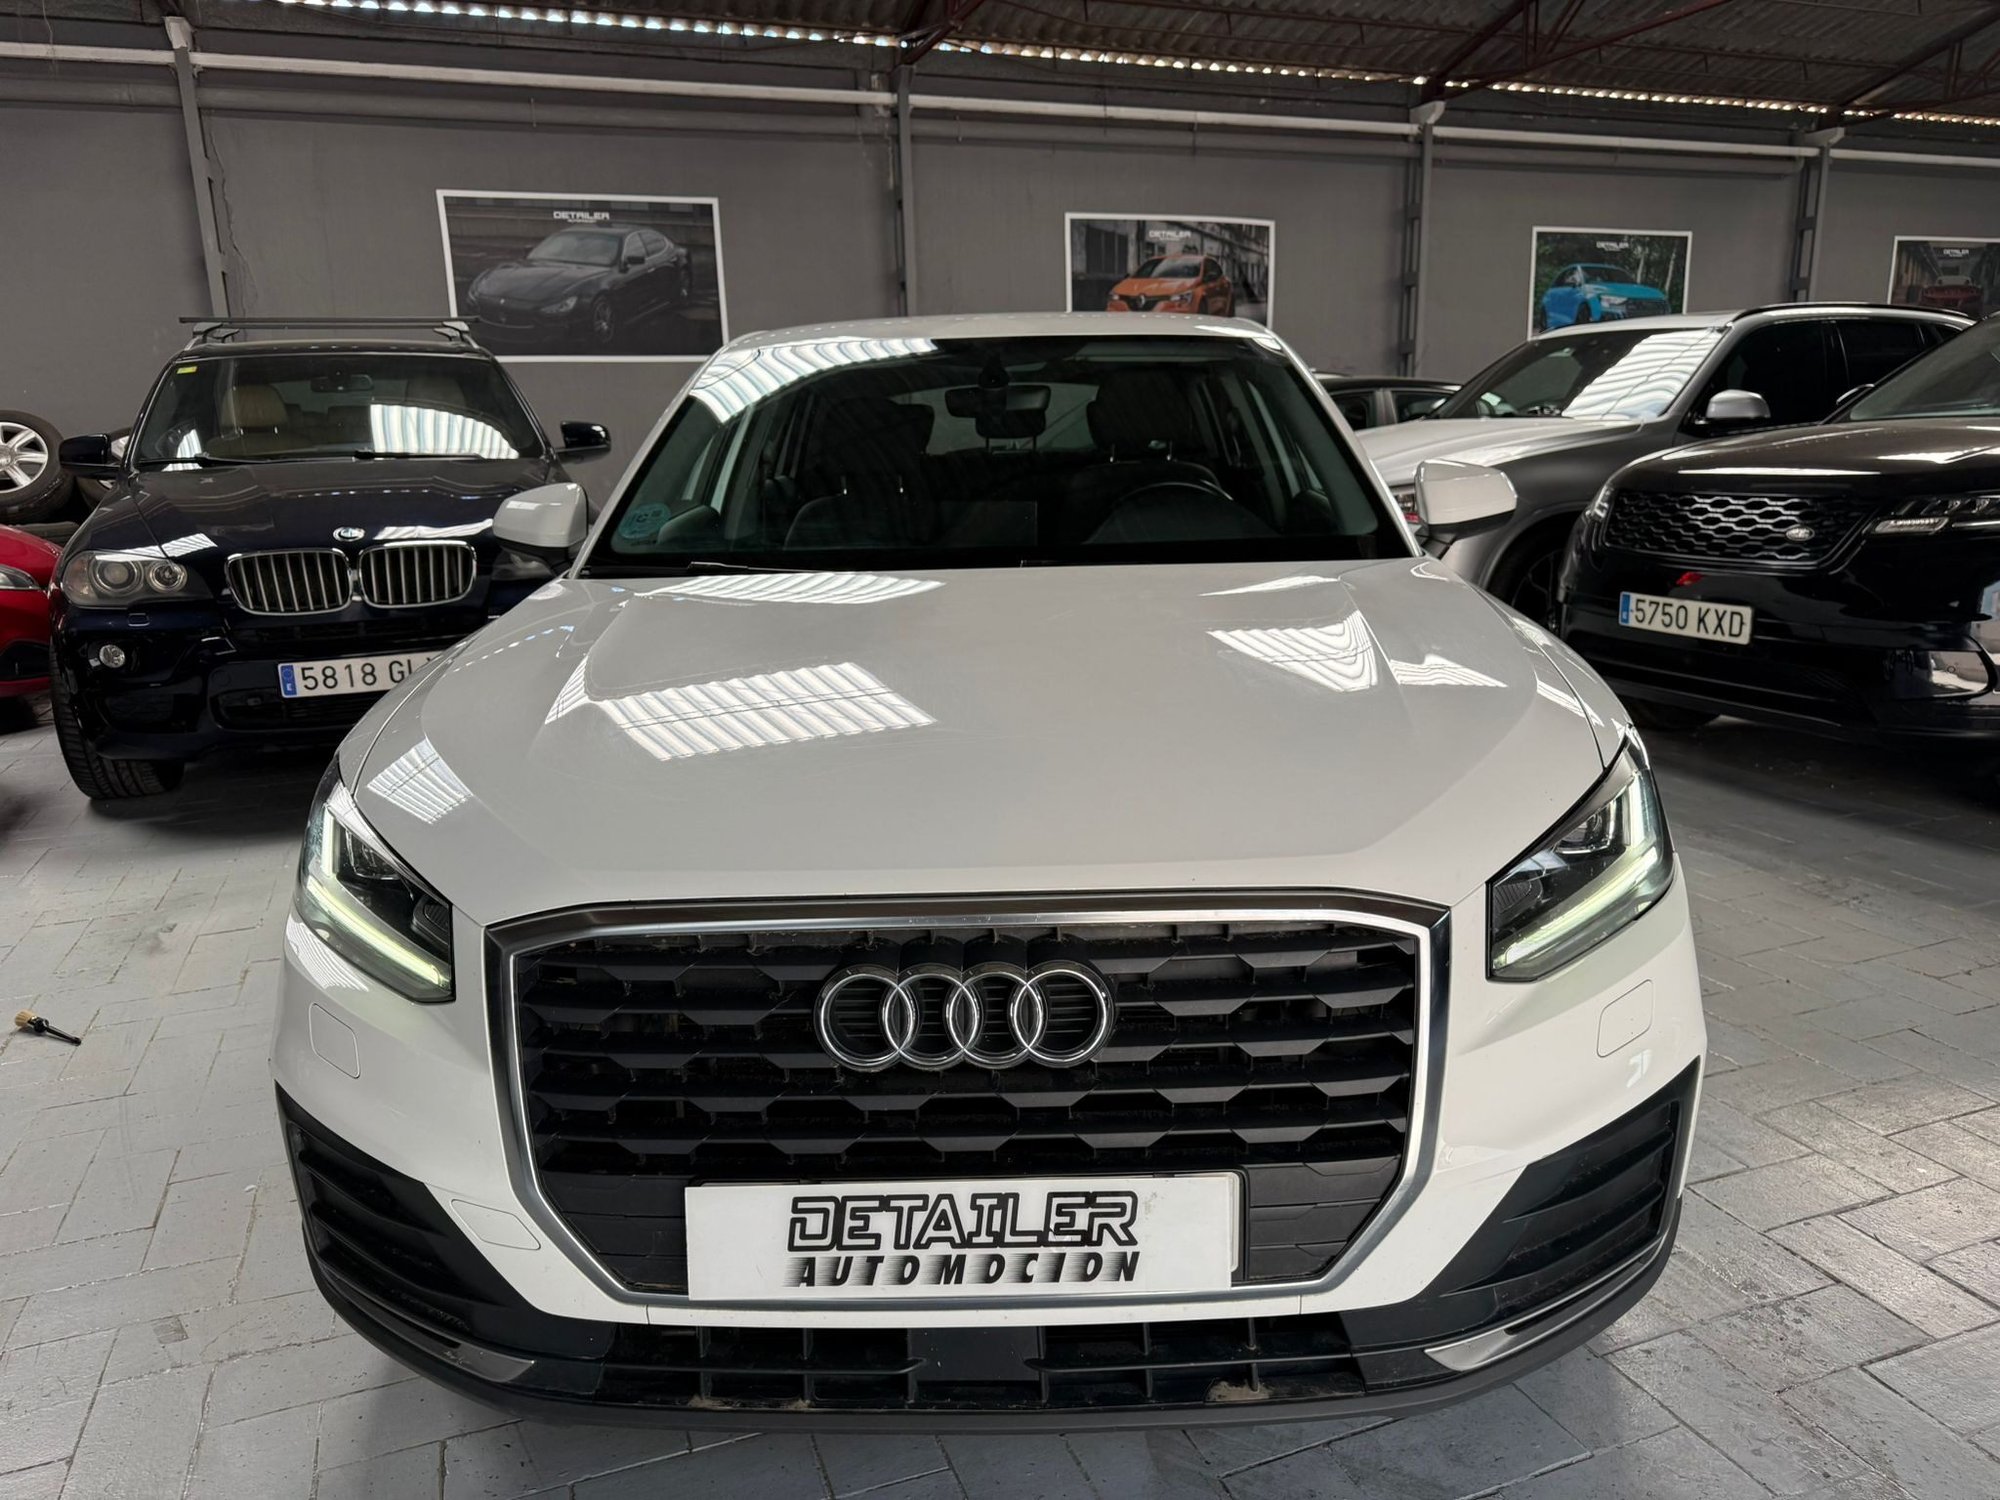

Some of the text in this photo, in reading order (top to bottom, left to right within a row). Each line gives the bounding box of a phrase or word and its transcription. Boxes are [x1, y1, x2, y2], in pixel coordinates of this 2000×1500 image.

[553, 210, 610, 221] DETAILER
[1634, 598, 1744, 638] 5750 KXD
[301, 662, 377, 691] 5818
[787, 1190, 1139, 1252] DETAILER
[781, 1250, 1140, 1288] AUTOMOCION
